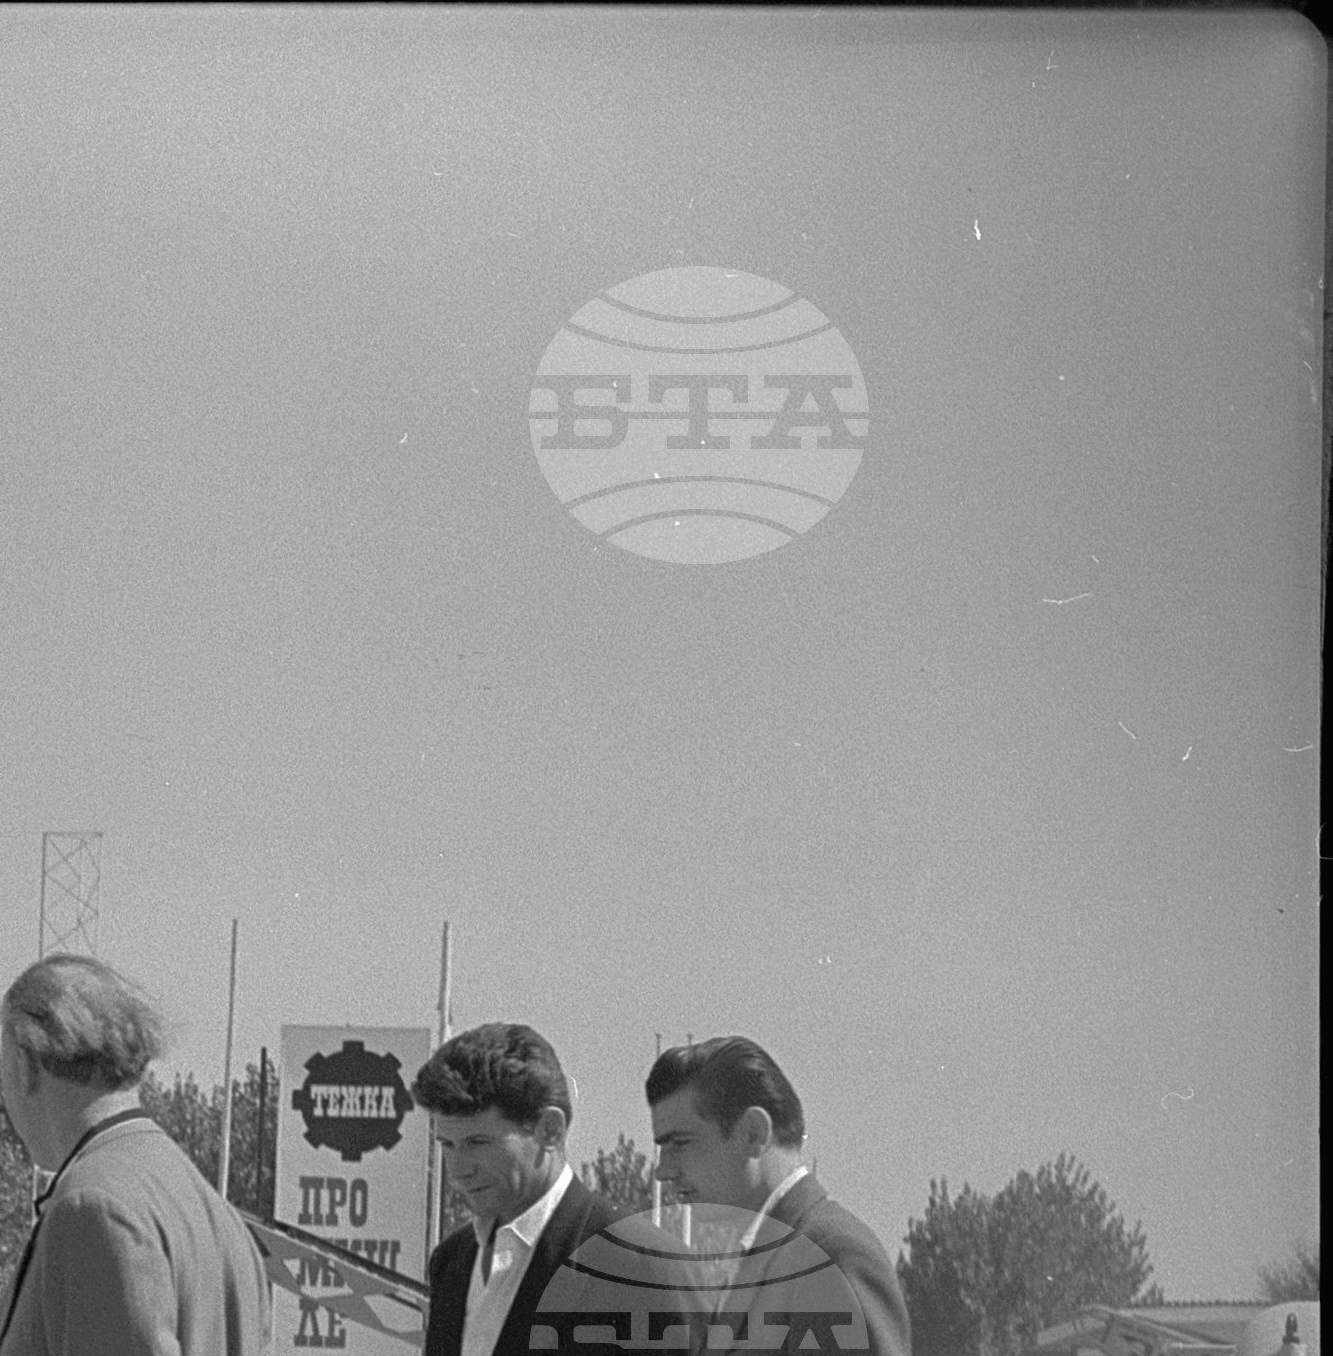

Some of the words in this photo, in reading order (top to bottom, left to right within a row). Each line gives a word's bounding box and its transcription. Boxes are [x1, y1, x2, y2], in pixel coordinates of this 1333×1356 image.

[310, 1084, 397, 1119] ТЕЖКА
[298, 1176, 369, 1228] ПРО
[294, 1299, 346, 1348] ЛЕ
